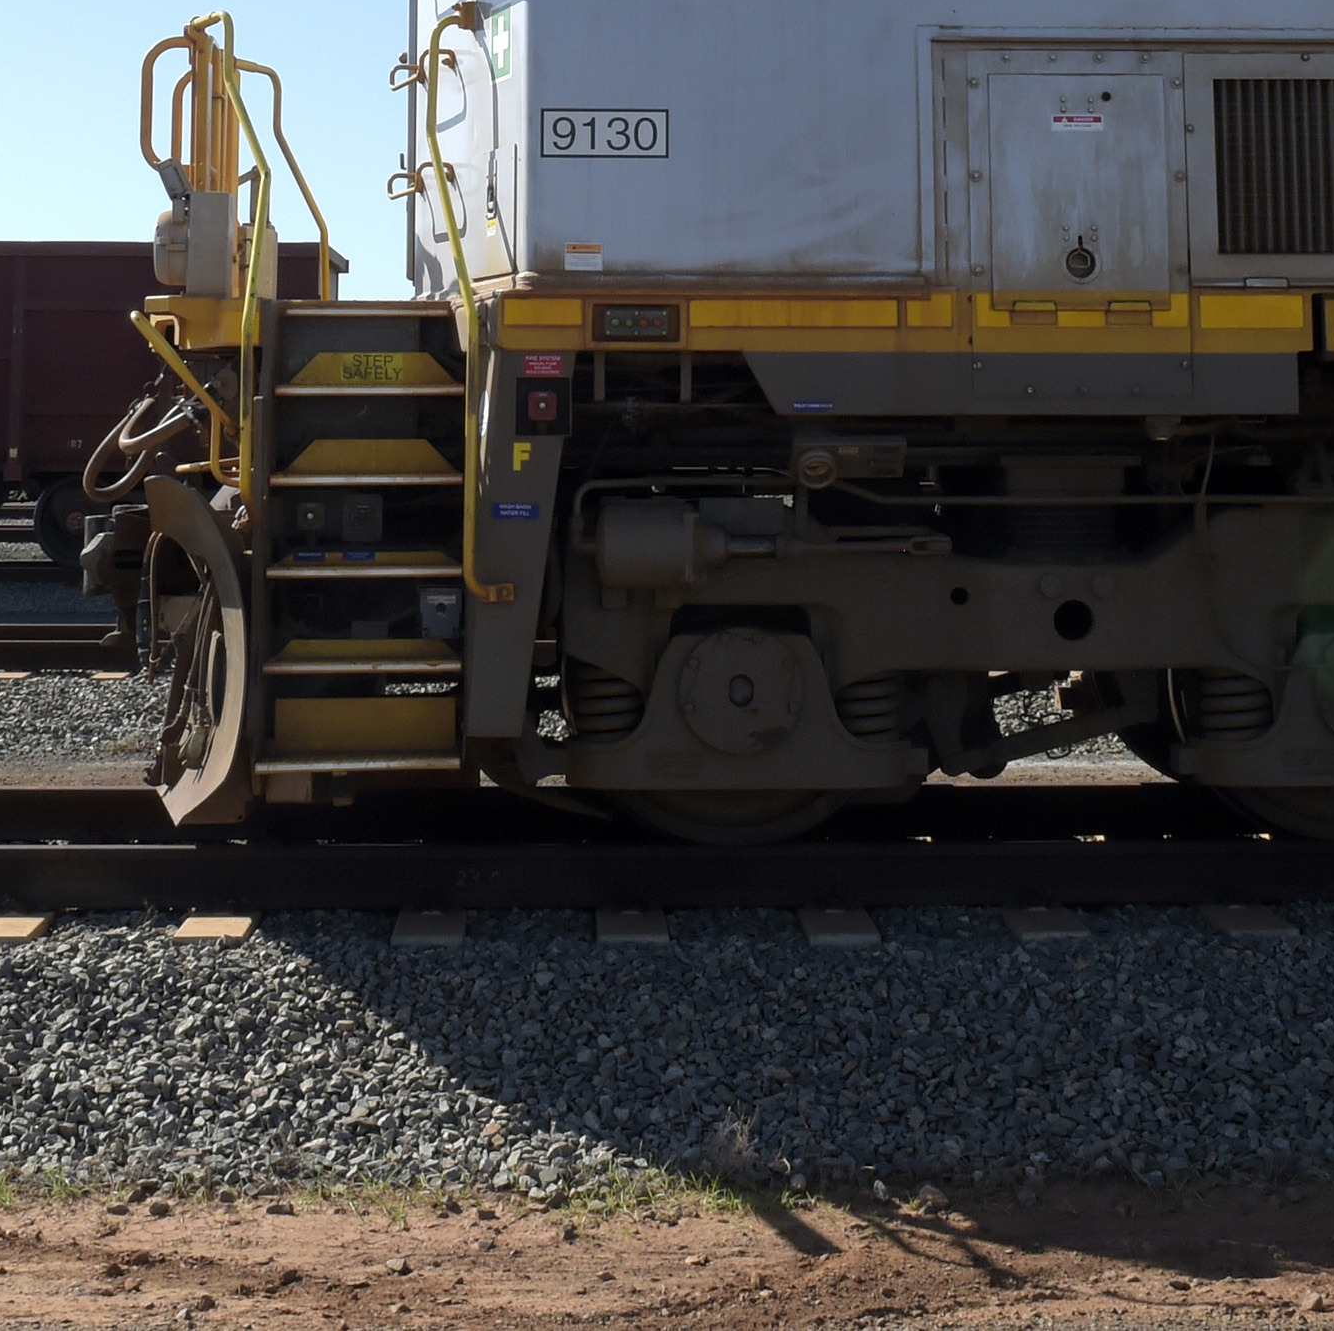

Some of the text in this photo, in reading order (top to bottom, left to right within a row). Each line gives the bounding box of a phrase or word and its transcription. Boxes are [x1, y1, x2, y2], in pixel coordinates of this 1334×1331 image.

[551, 116, 658, 150] 9130
[352, 355, 394, 367] STEP
[342, 367, 402, 380] SAFELY
[513, 442, 532, 472] F
